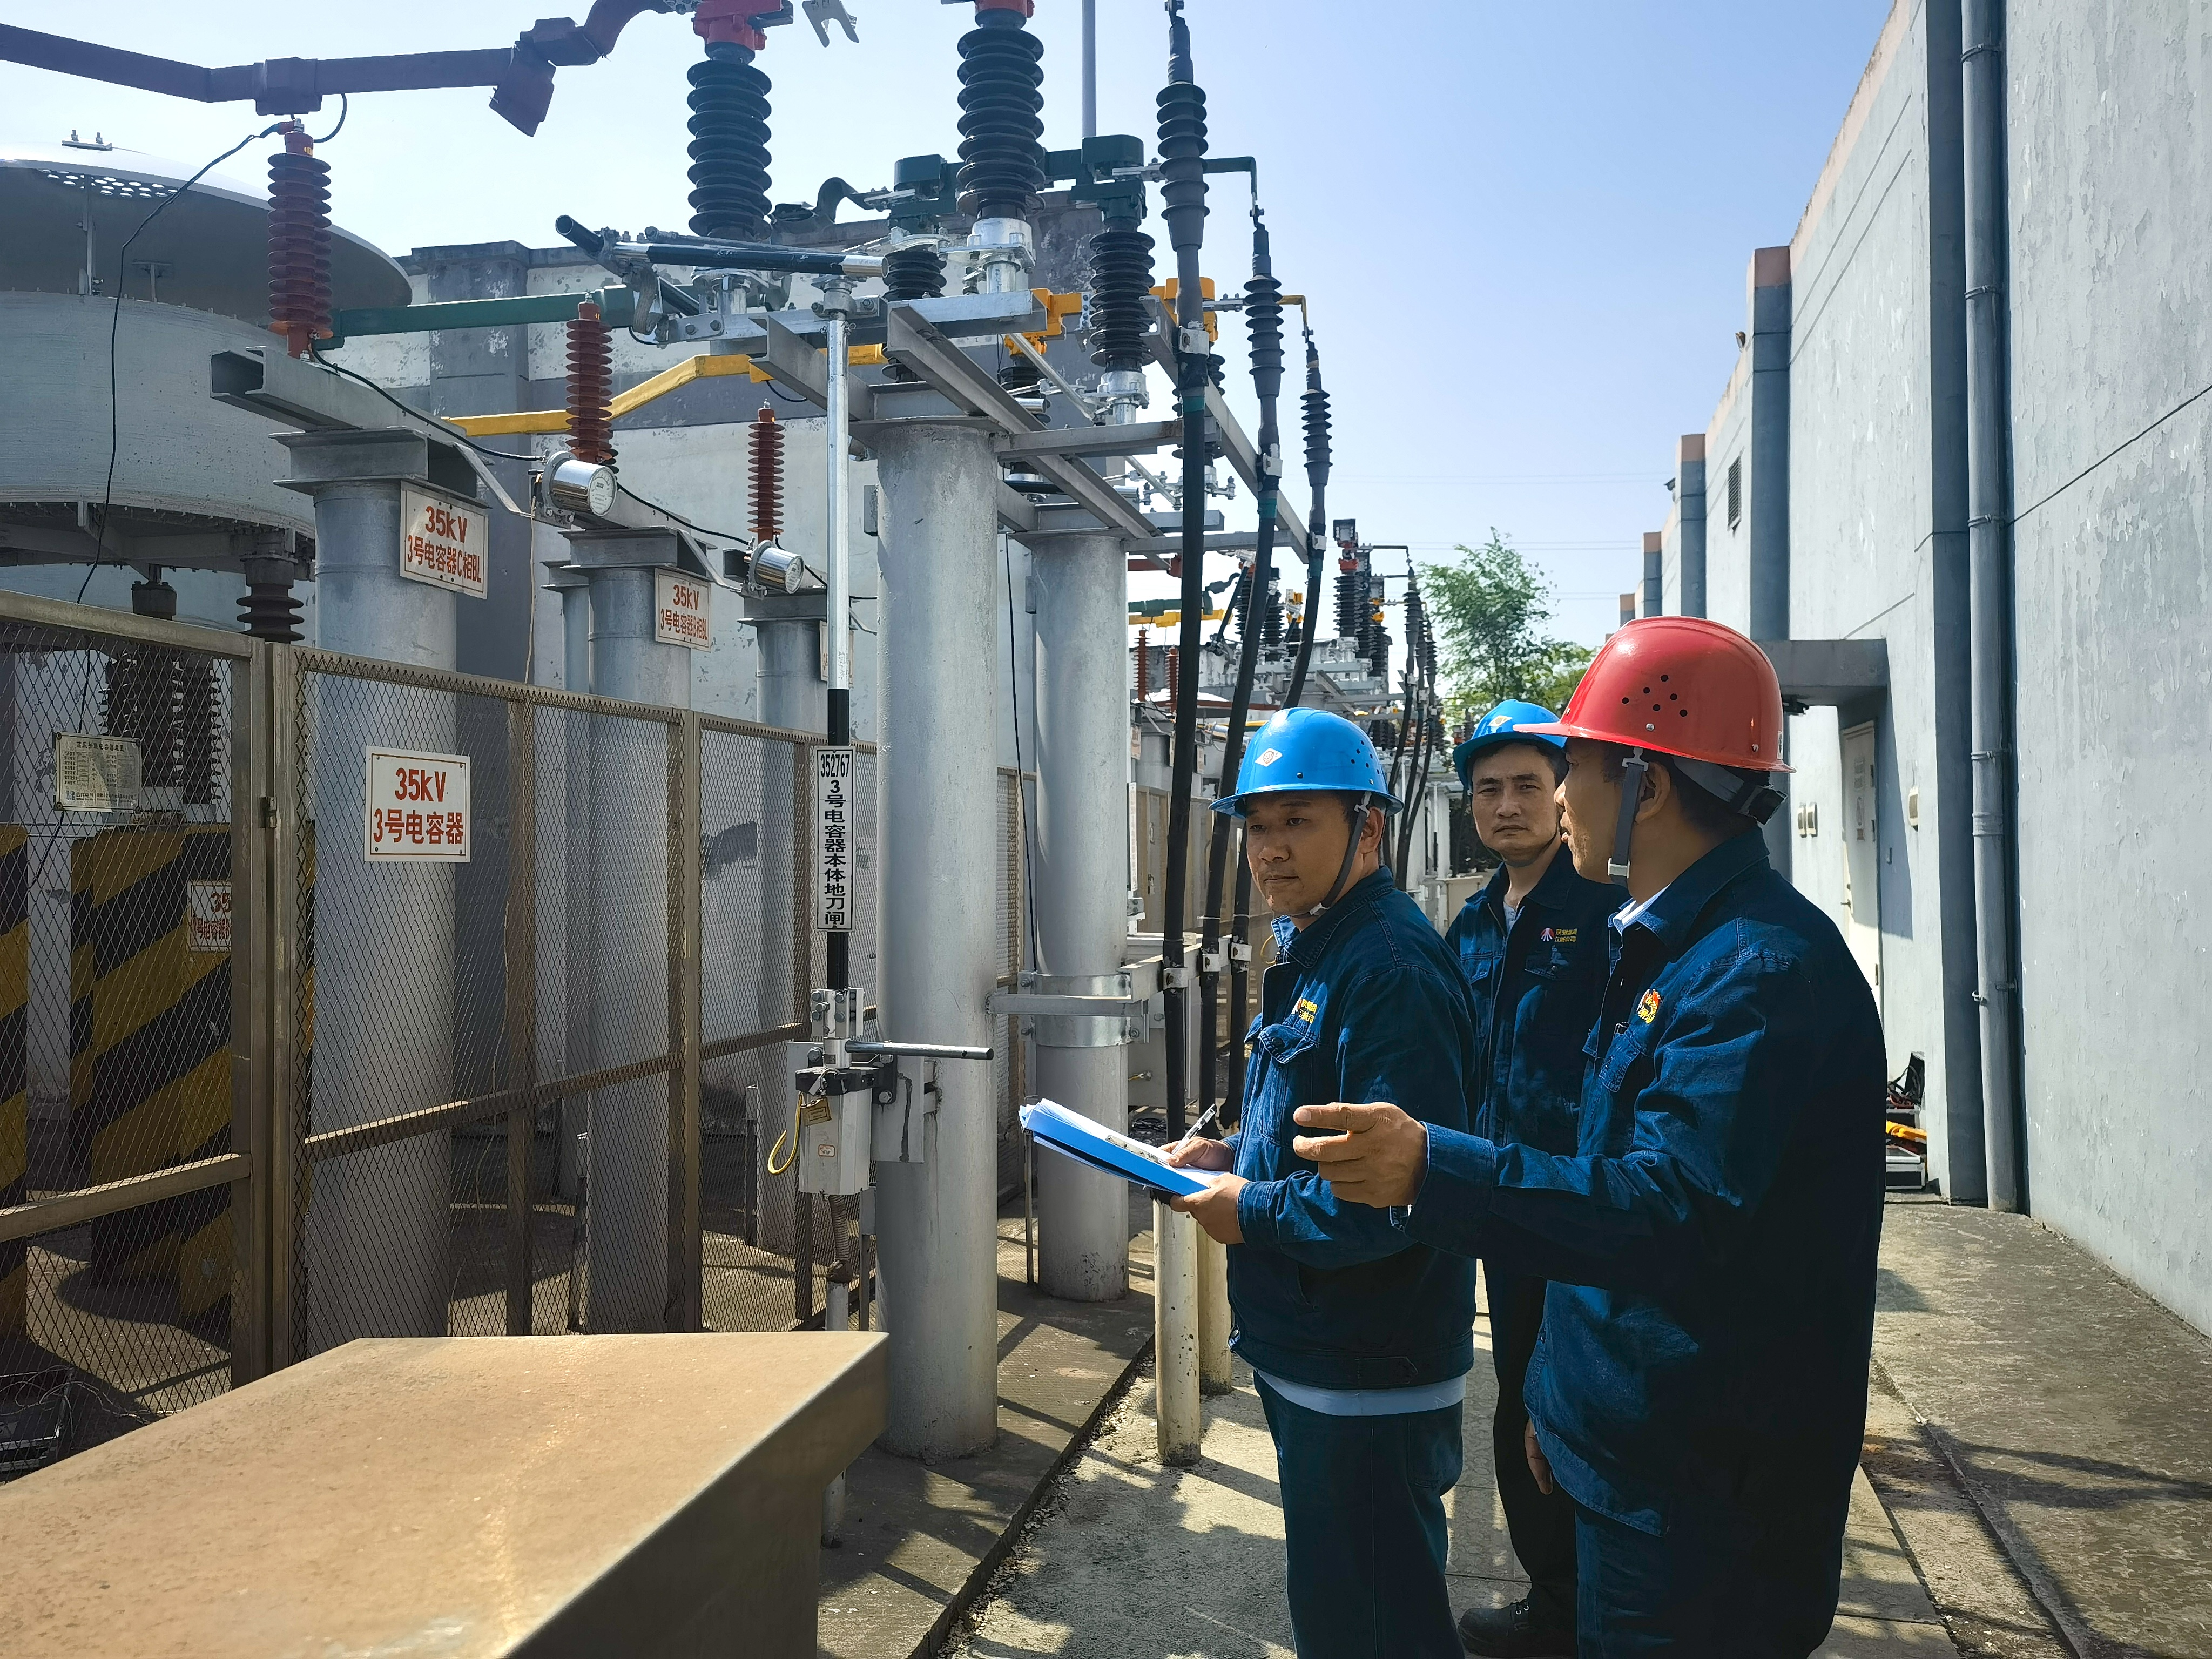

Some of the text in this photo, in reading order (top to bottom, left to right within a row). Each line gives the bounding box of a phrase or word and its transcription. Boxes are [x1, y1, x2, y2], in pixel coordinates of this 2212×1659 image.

[425, 506, 468, 543] 35kV
[408, 534, 482, 583] 3号电容器C相BL
[673, 584, 699, 610] 35kV
[820, 754, 850, 778] 352767
[395, 767, 447, 802] 35kV
[373, 808, 464, 844] 3号电容器
[824, 779, 847, 925] 3号电容器本体地刀闸
